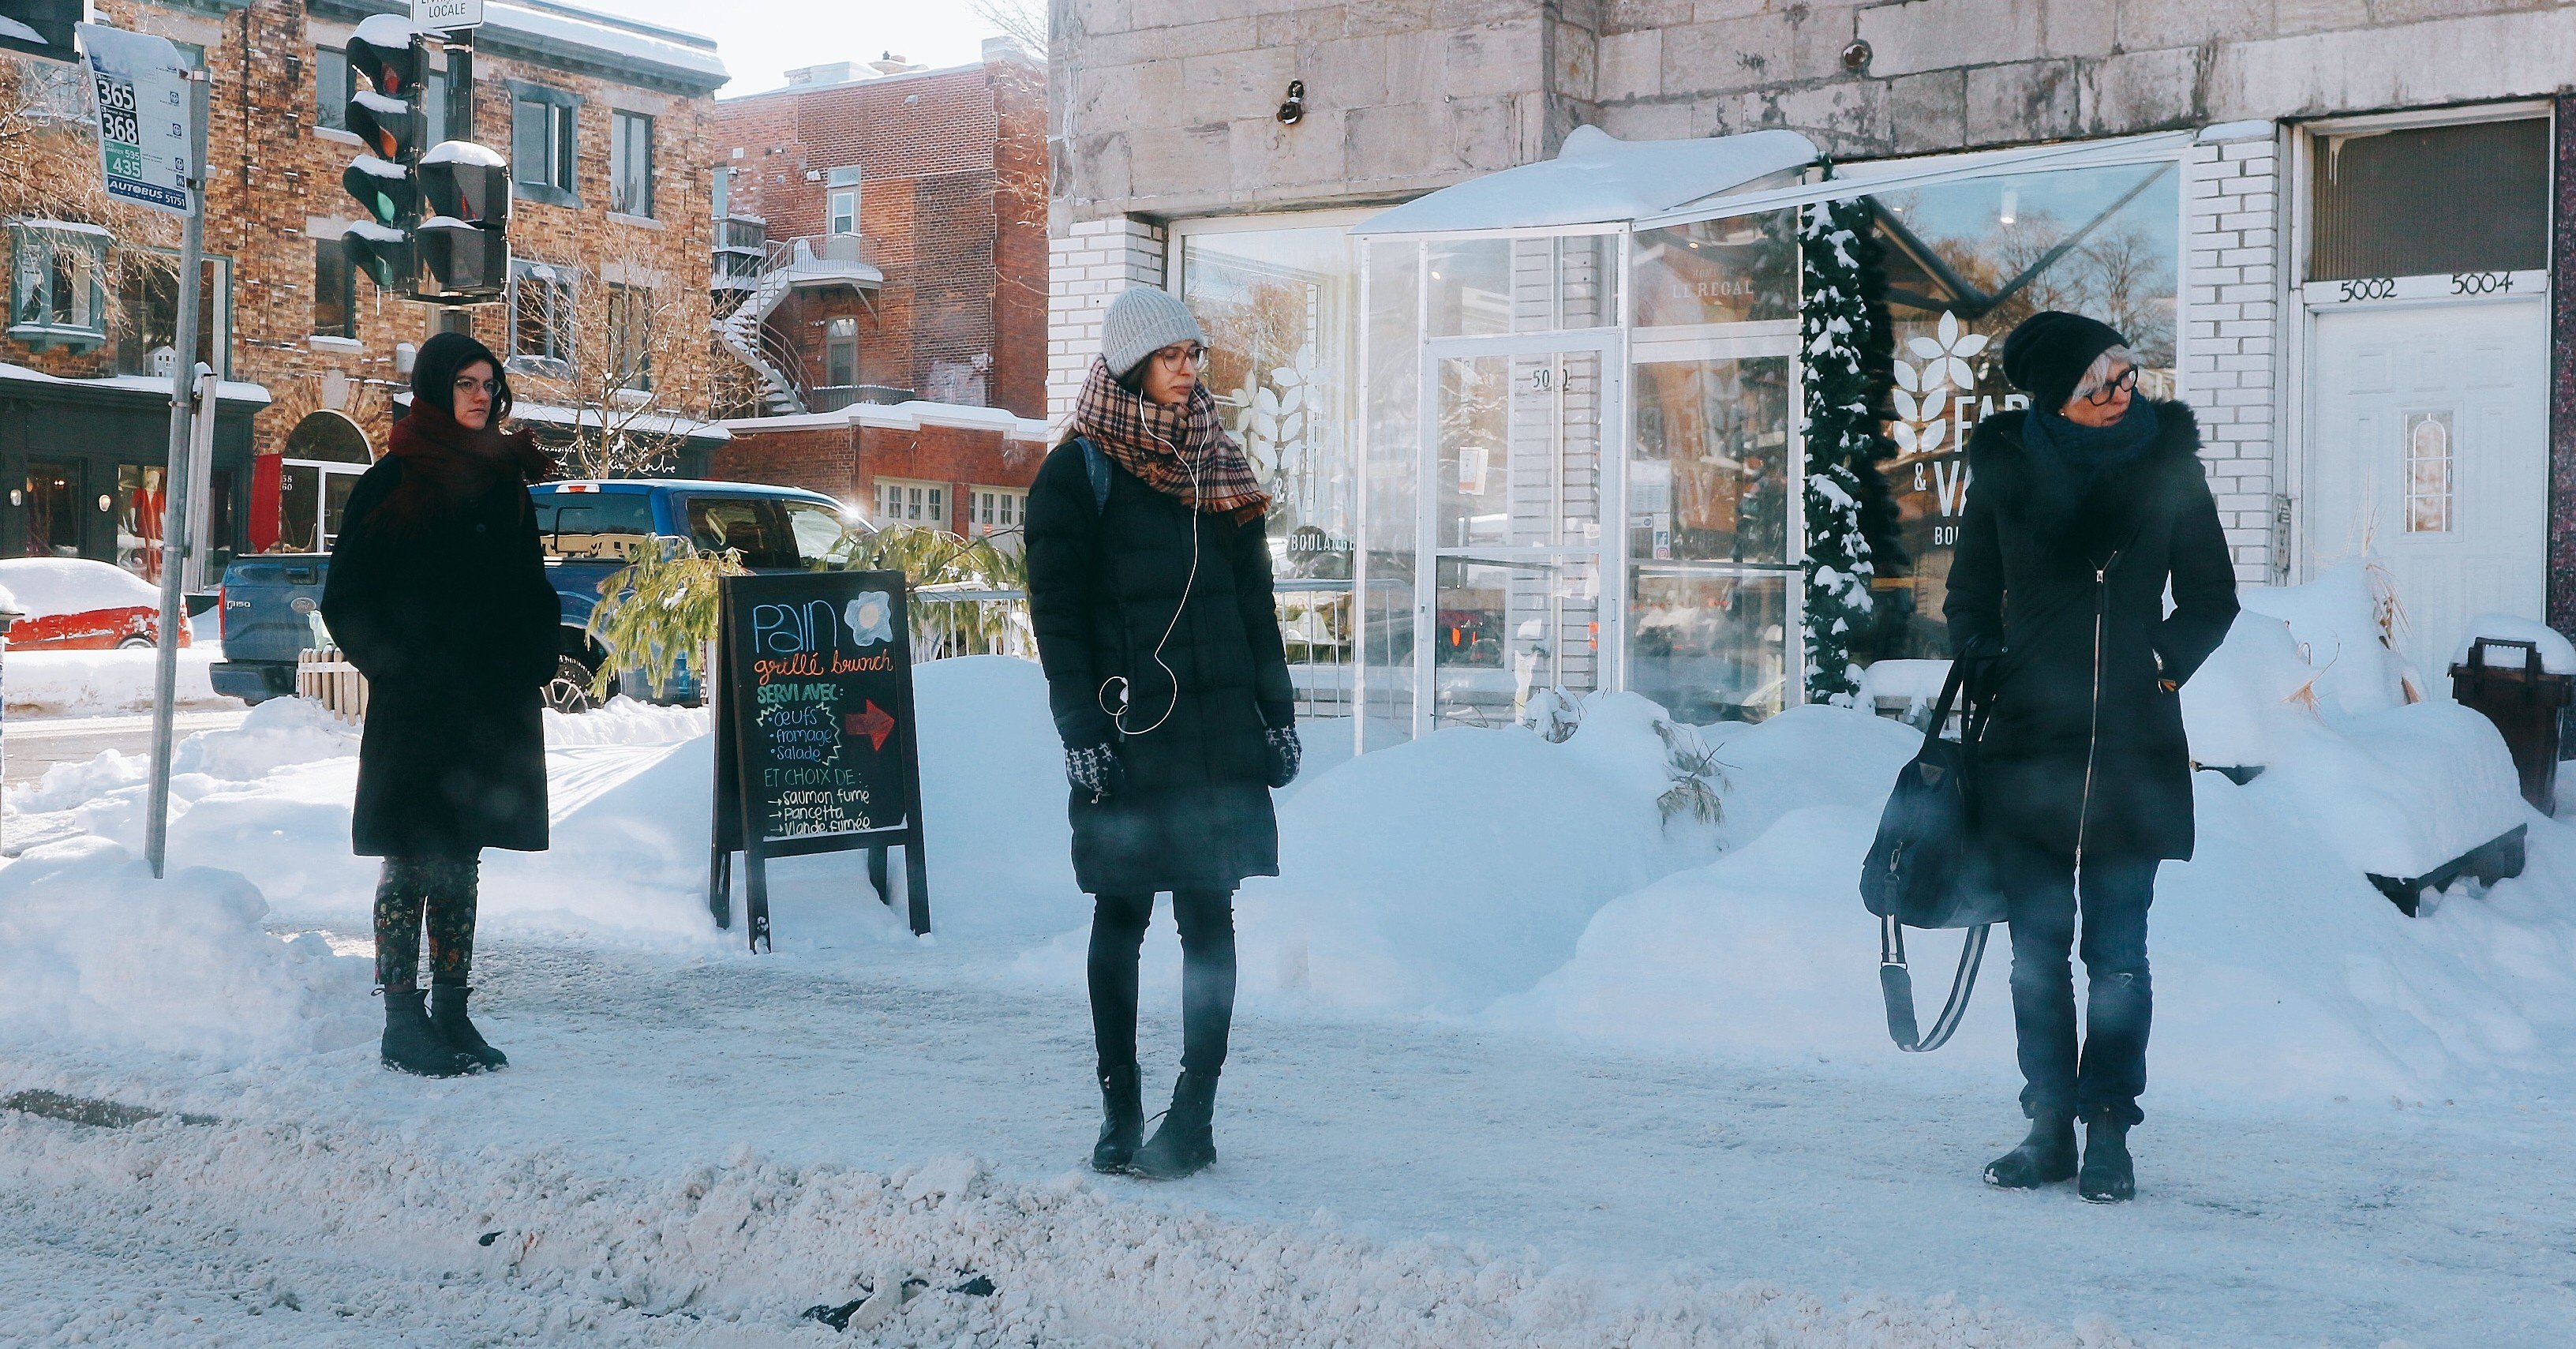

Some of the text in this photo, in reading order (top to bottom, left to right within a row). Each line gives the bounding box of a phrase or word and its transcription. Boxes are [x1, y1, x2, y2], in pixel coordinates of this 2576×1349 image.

[429, 3, 466, 18] LOCALE
[98, 81, 134, 110] 365
[103, 113, 137, 144] 368
[125, 149, 140, 160] 535
[113, 158, 141, 178] 435
[109, 180, 163, 199] AUTOBUS
[165, 194, 185, 207] 51751
[1673, 283, 1690, 298] LE
[2339, 278, 2398, 302] 5002
[2451, 271, 2513, 294] 5004
[1915, 463, 1926, 491] &
[1274, 476, 1285, 504] &
[754, 649, 893, 685] grillé brunch
[757, 684, 799, 704] SERVI
[777, 729, 833, 747] fromage
[765, 768, 781, 787] ET
[784, 767, 831, 785] CHOIX
[837, 785, 870, 804] fumé
